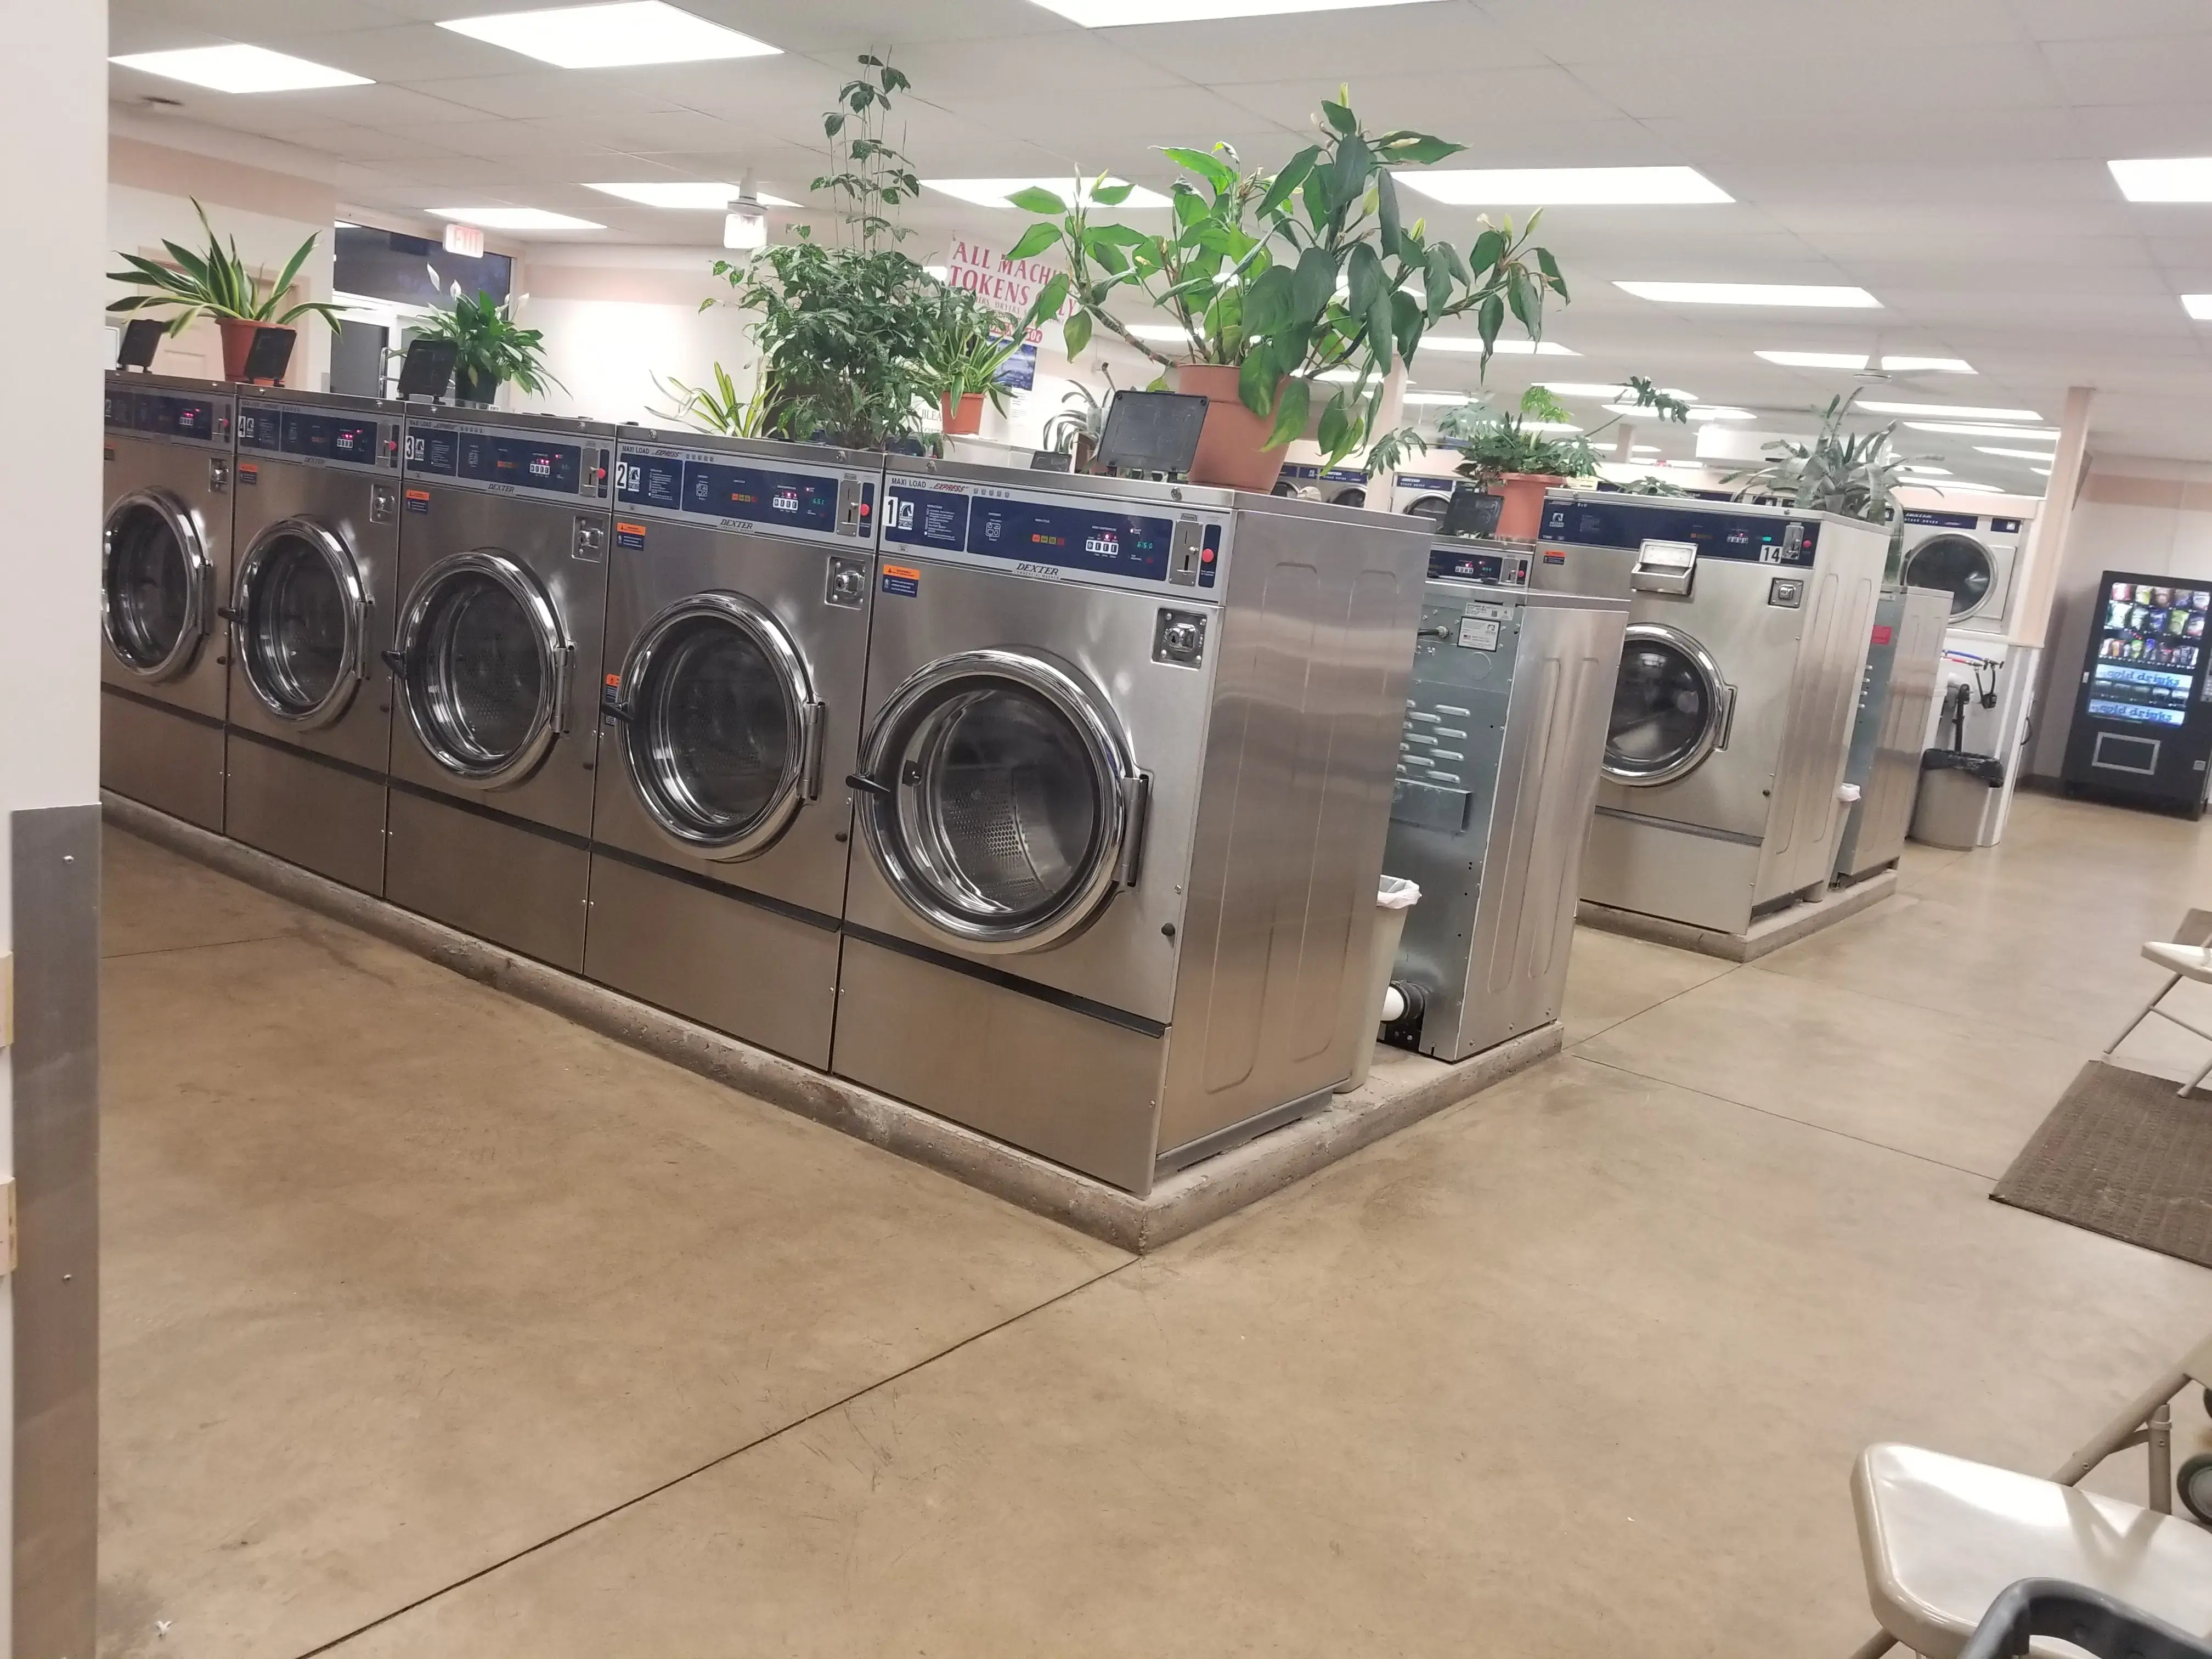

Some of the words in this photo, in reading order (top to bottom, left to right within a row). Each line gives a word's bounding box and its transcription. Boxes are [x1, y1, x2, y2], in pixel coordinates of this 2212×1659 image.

[454, 227, 479, 253] EXIT
[952, 241, 990, 269] ALL
[948, 265, 1030, 306] TOKENS
[239, 417, 244, 436] 4
[406, 437, 413, 458] 3
[654, 449, 680, 458] EXPRESS
[617, 464, 625, 487] 2
[488, 483, 515, 493] DEXTER
[891, 477, 907, 486] MAXI
[909, 479, 927, 488] LOAD
[933, 483, 966, 493] EXPRESS
[888, 499, 894, 524] 1
[720, 518, 753, 529] DEXTER
[1764, 546, 1781, 562] 14
[1015, 562, 1059, 575] DEXTER
[2137, 673, 2180, 686] drinks
[2129, 707, 2173, 722] drinks
